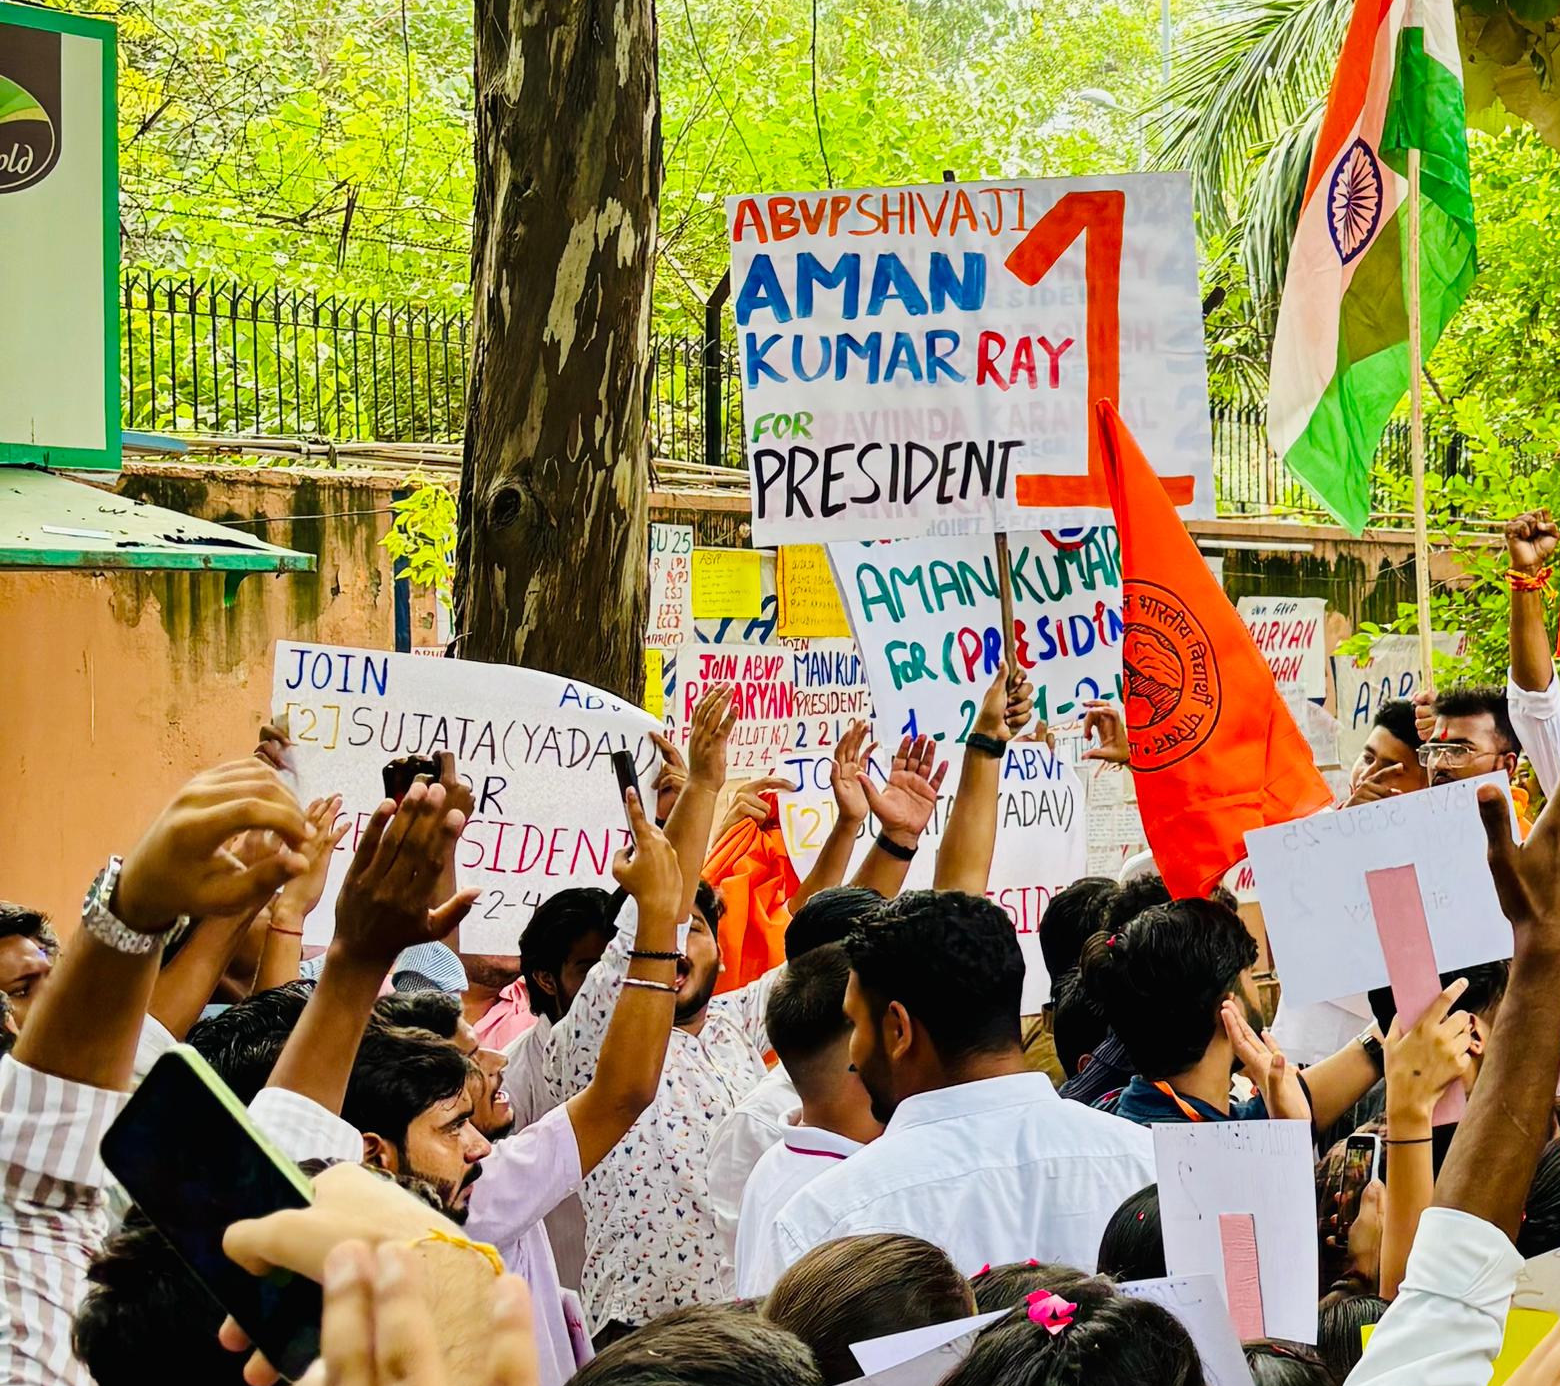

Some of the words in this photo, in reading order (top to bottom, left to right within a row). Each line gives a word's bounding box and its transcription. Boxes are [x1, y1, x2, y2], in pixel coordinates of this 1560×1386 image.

[735, 252, 986, 326] AMAN
[745, 330, 967, 390] KUMAR
[976, 330, 1075, 391] RAY
[751, 411, 814, 443] FOR
[753, 440, 1026, 520] PRESIDENT
[856, 555, 1002, 624] AMAN
[286, 649, 388, 696] JOIN
[742, 654, 784, 681] ABVP
[793, 650, 833, 688] MAN
